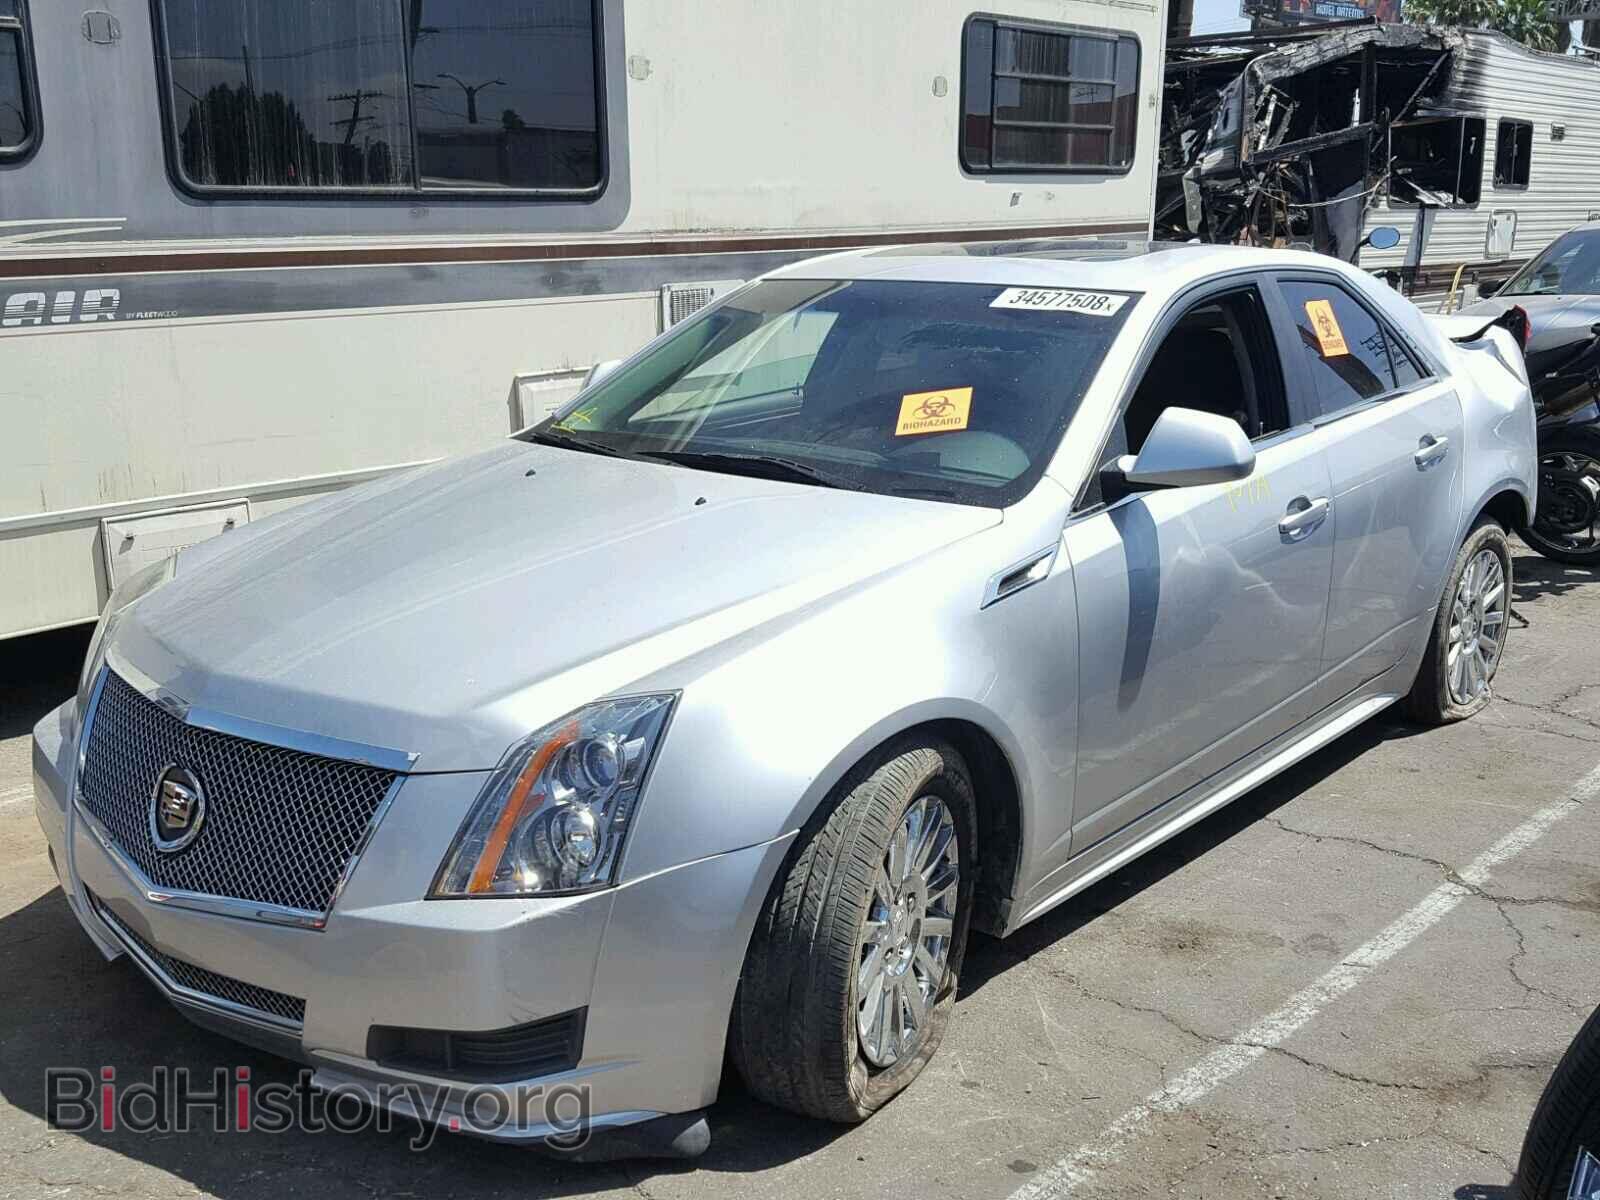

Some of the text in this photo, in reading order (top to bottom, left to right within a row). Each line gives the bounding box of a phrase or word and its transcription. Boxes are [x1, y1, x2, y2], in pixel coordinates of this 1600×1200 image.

[2, 288, 121, 326] AIR
[136, 310, 178, 319] FLEETWOOD
[902, 416, 961, 431] BIOHAZARD
